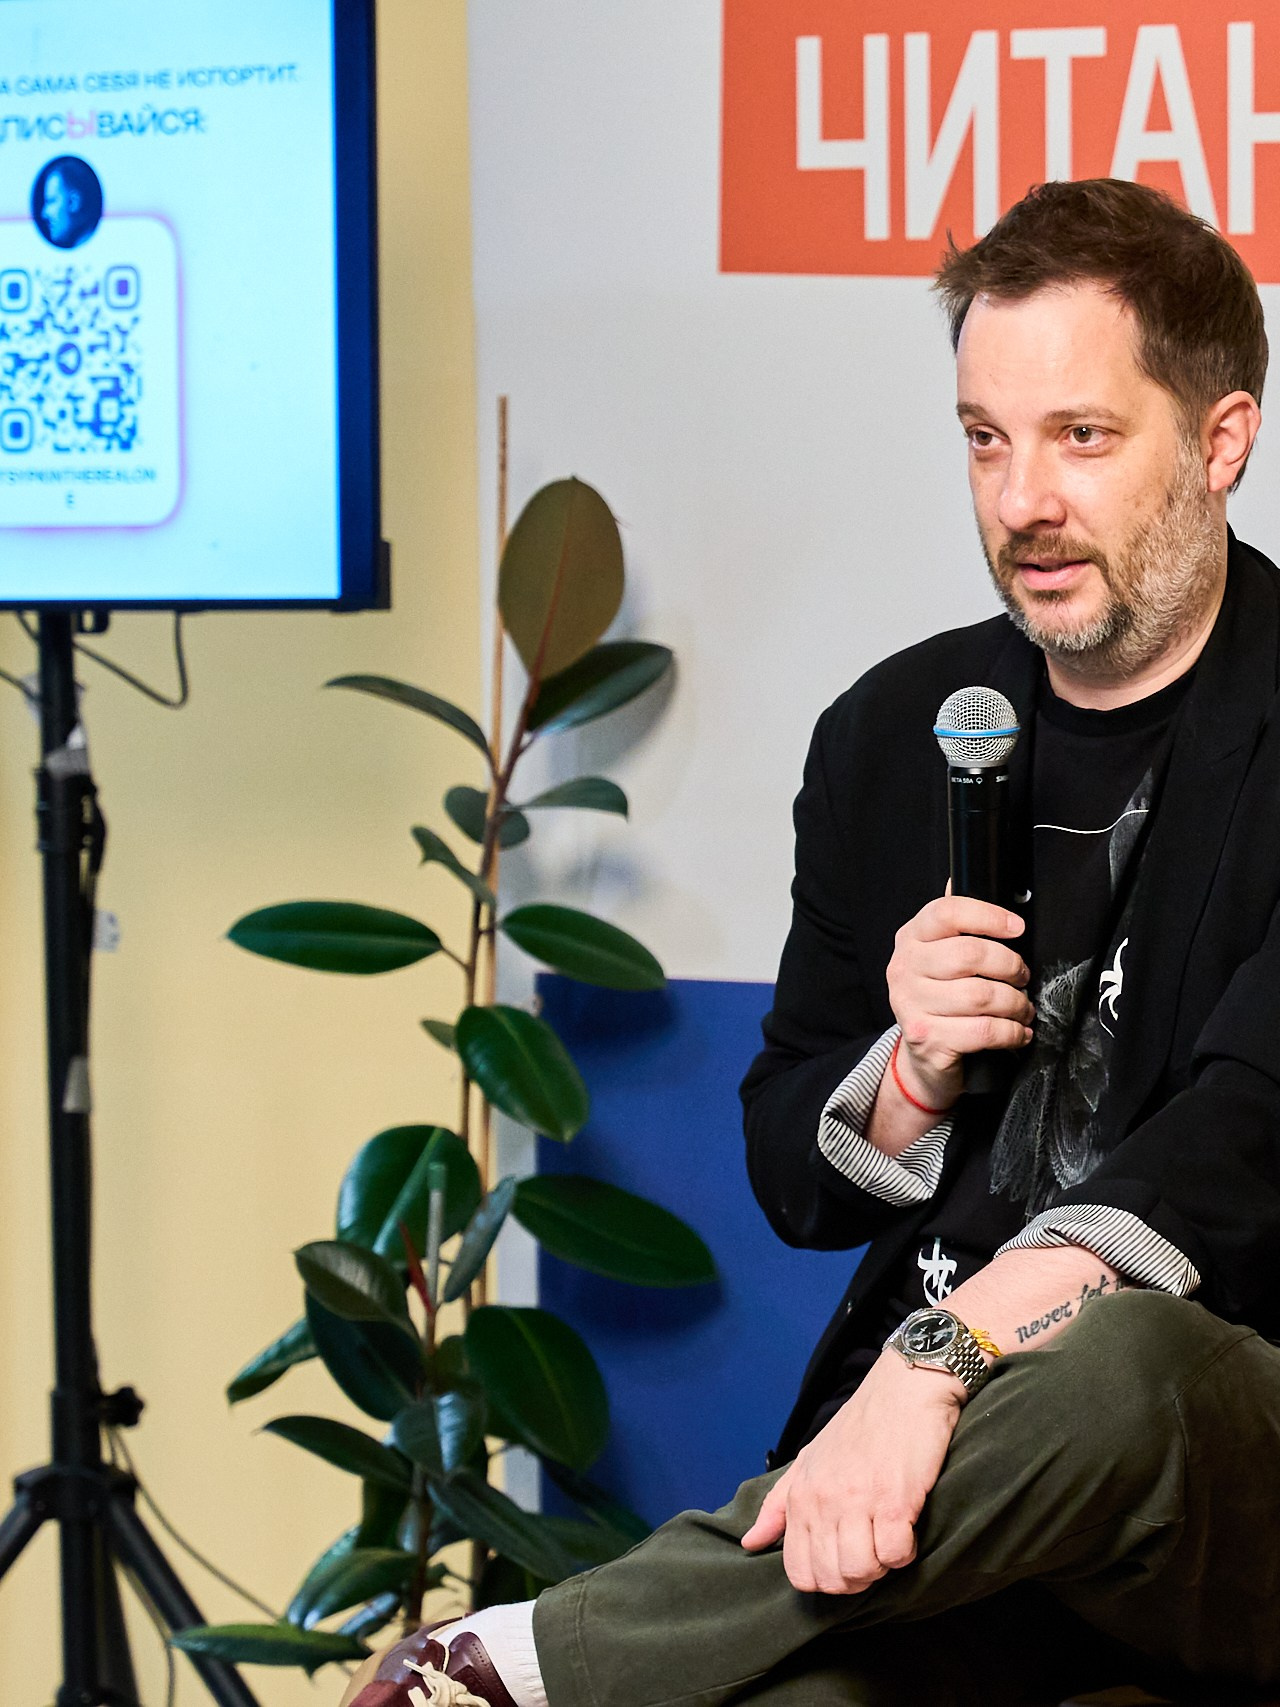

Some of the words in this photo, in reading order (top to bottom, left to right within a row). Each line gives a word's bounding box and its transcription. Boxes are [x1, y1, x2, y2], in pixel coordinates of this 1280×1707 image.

[15, 74, 78, 96] САМА
[84, 71, 139, 92] СЕБЯ
[145, 68, 172, 88] НЕ
[1015, 1301, 1072, 1343] never
